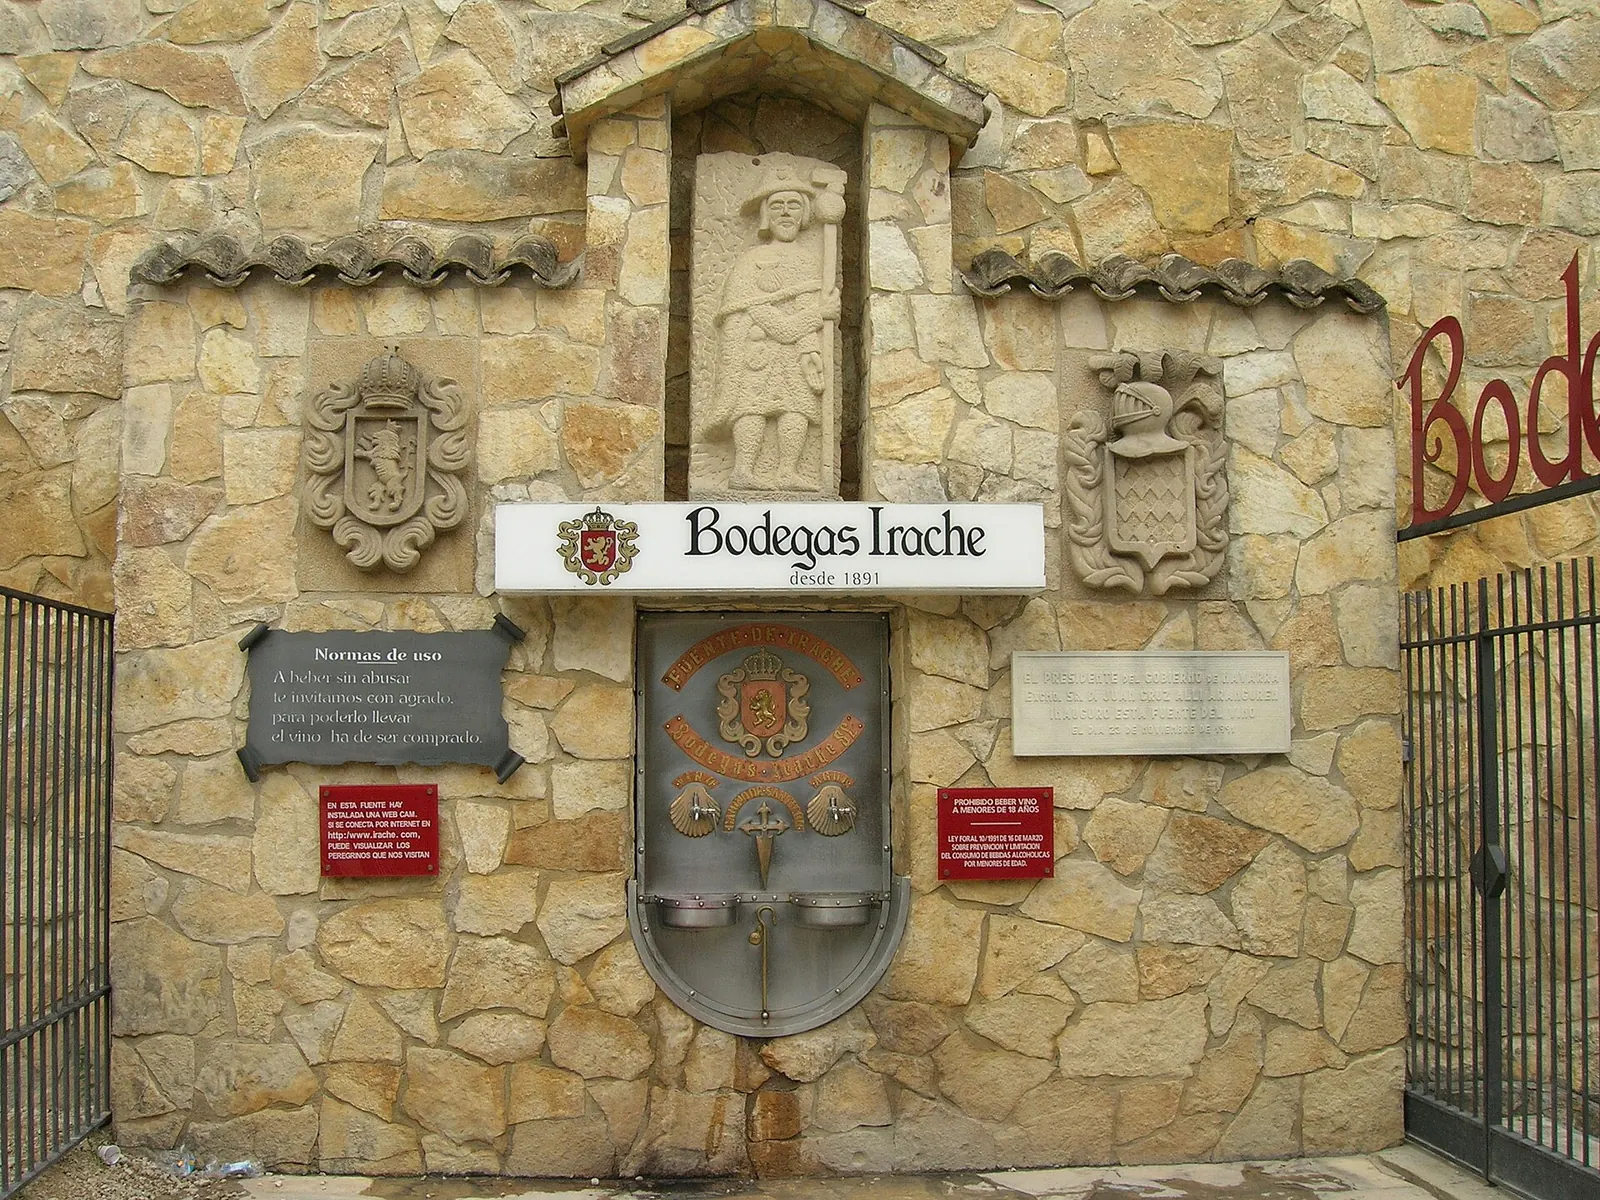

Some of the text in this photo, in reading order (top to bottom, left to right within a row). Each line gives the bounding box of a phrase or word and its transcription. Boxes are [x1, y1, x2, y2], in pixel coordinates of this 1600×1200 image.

[684, 506, 987, 571] Bodegas Irache
[789, 571, 881, 586] desde 1891
[315, 648, 442, 662] Normas de uso
[751, 627, 777, 643] DE
[787, 629, 857, 683] IRACHE
[273, 670, 411, 684] A beber sin abusar
[1024, 673, 1279, 684] EL PRESIDENTE DEL GOBIERNO DE NAVARRA
[273, 691, 287, 704] te
[291, 691, 362, 704] invitamos
[367, 693, 394, 704] con
[1103, 690, 1135, 702] JUAN
[1140, 691, 1170, 702] CRUZ
[272, 710, 412, 726] para poderlo llevar
[1115, 708, 1147, 719] ESTA
[1151, 708, 1197, 719] FUENTE
[1201, 708, 1223, 719] DEL
[1072, 726, 1084, 736] EL
[1125, 726, 1137, 736] DE
[1142, 725, 1195, 735] NOVIEMBRE
[1200, 725, 1211, 735] DE
[271, 730, 483, 747] el vino ha de ser comprado.
[360, 801, 386, 809] FUENTE
[954, 798, 1038, 806] PROHIBIDO BEBER VINO
[327, 811, 365, 819] INSTALADA
[366, 811, 380, 819] UNA
[399, 810, 418, 818] CAM.
[952, 806, 960, 814] A
[960, 806, 995, 814] MENORES
[1017, 804, 1040, 813] AÑOS
[390, 820, 420, 828] INTERNET
[948, 835, 959, 843] LEY
[959, 835, 978, 843] FORAL
[1022, 834, 1044, 842] MARZO
[328, 841, 411, 850] PUEDE VISUALIZAR LOS
[372, 851, 387, 859] QUE
[388, 851, 403, 859] NOS
[964, 860, 976, 868] POR
